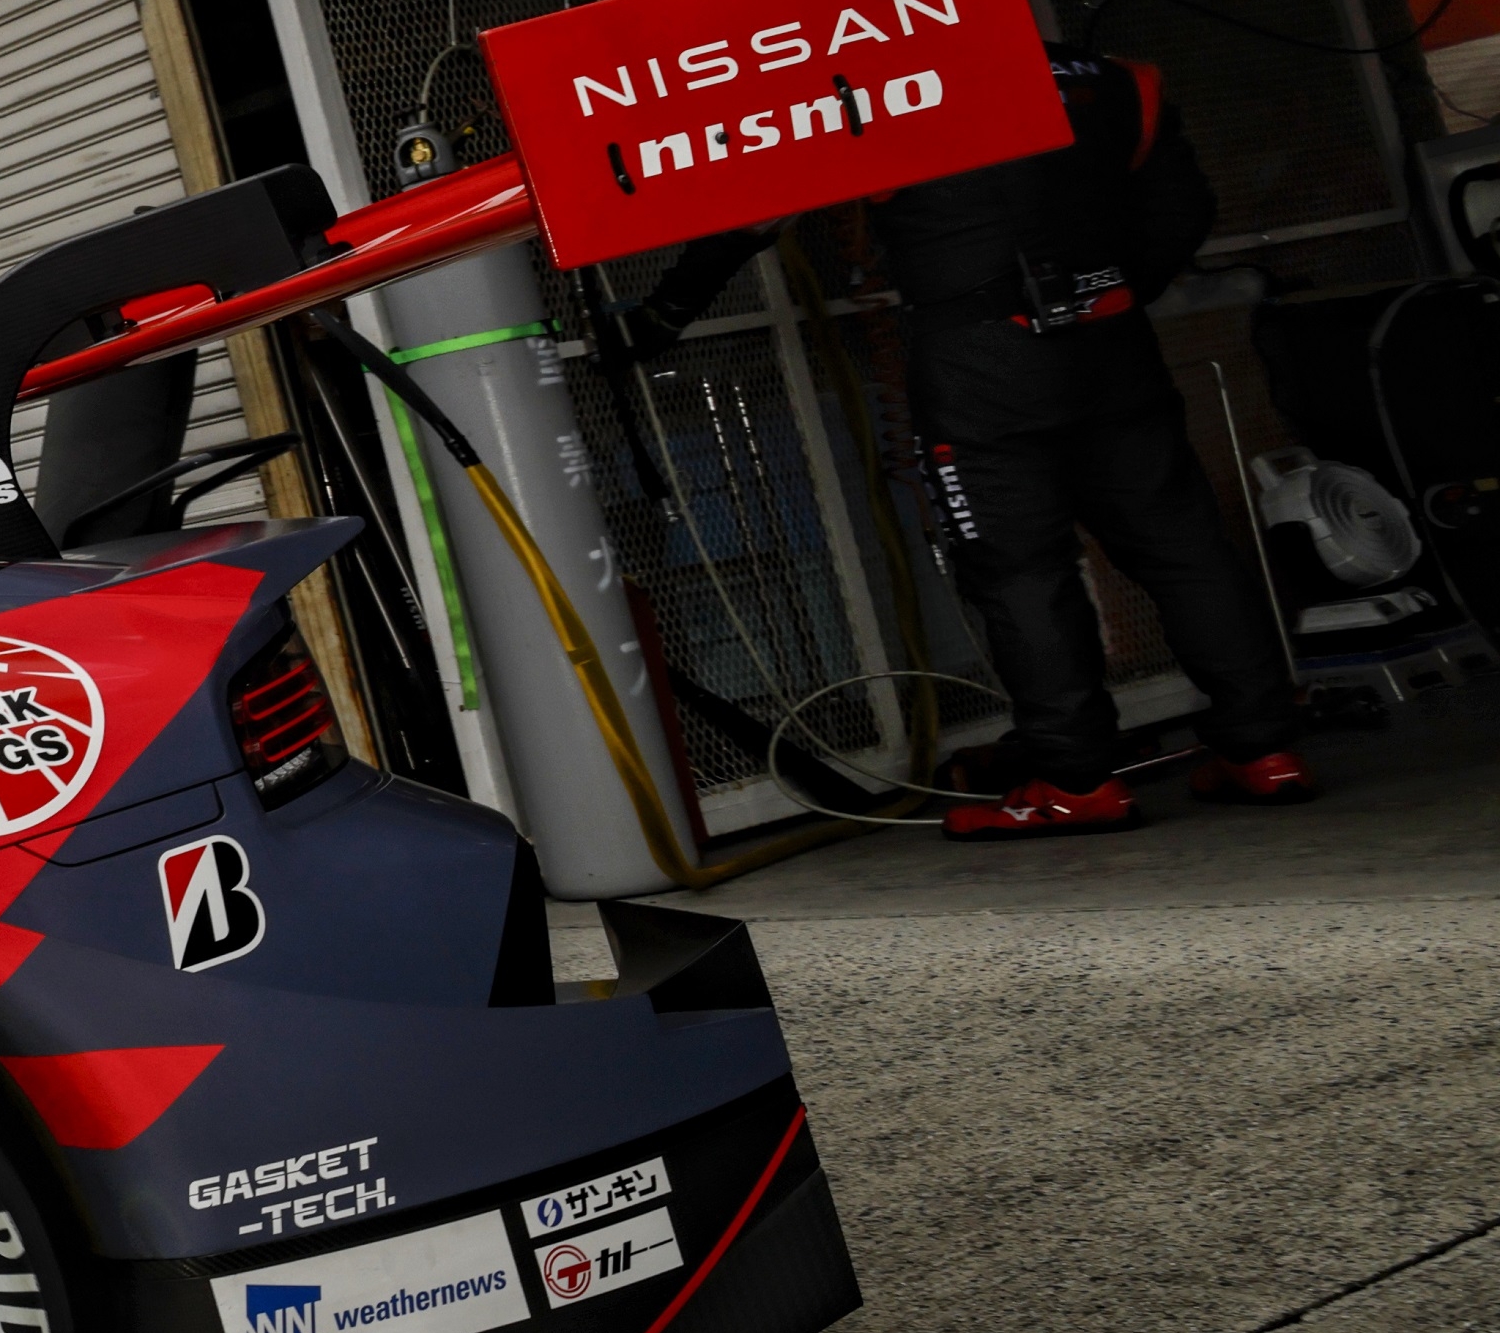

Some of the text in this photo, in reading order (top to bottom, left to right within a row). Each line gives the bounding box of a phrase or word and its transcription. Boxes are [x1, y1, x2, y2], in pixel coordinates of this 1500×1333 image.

[640, 69, 943, 178] nismo
[189, 1137, 378, 1210] GASKET
[565, 1170, 657, 1219] サンキン
[594, 1239, 674, 1279] カトー
[334, 1269, 507, 1331] weathernews
